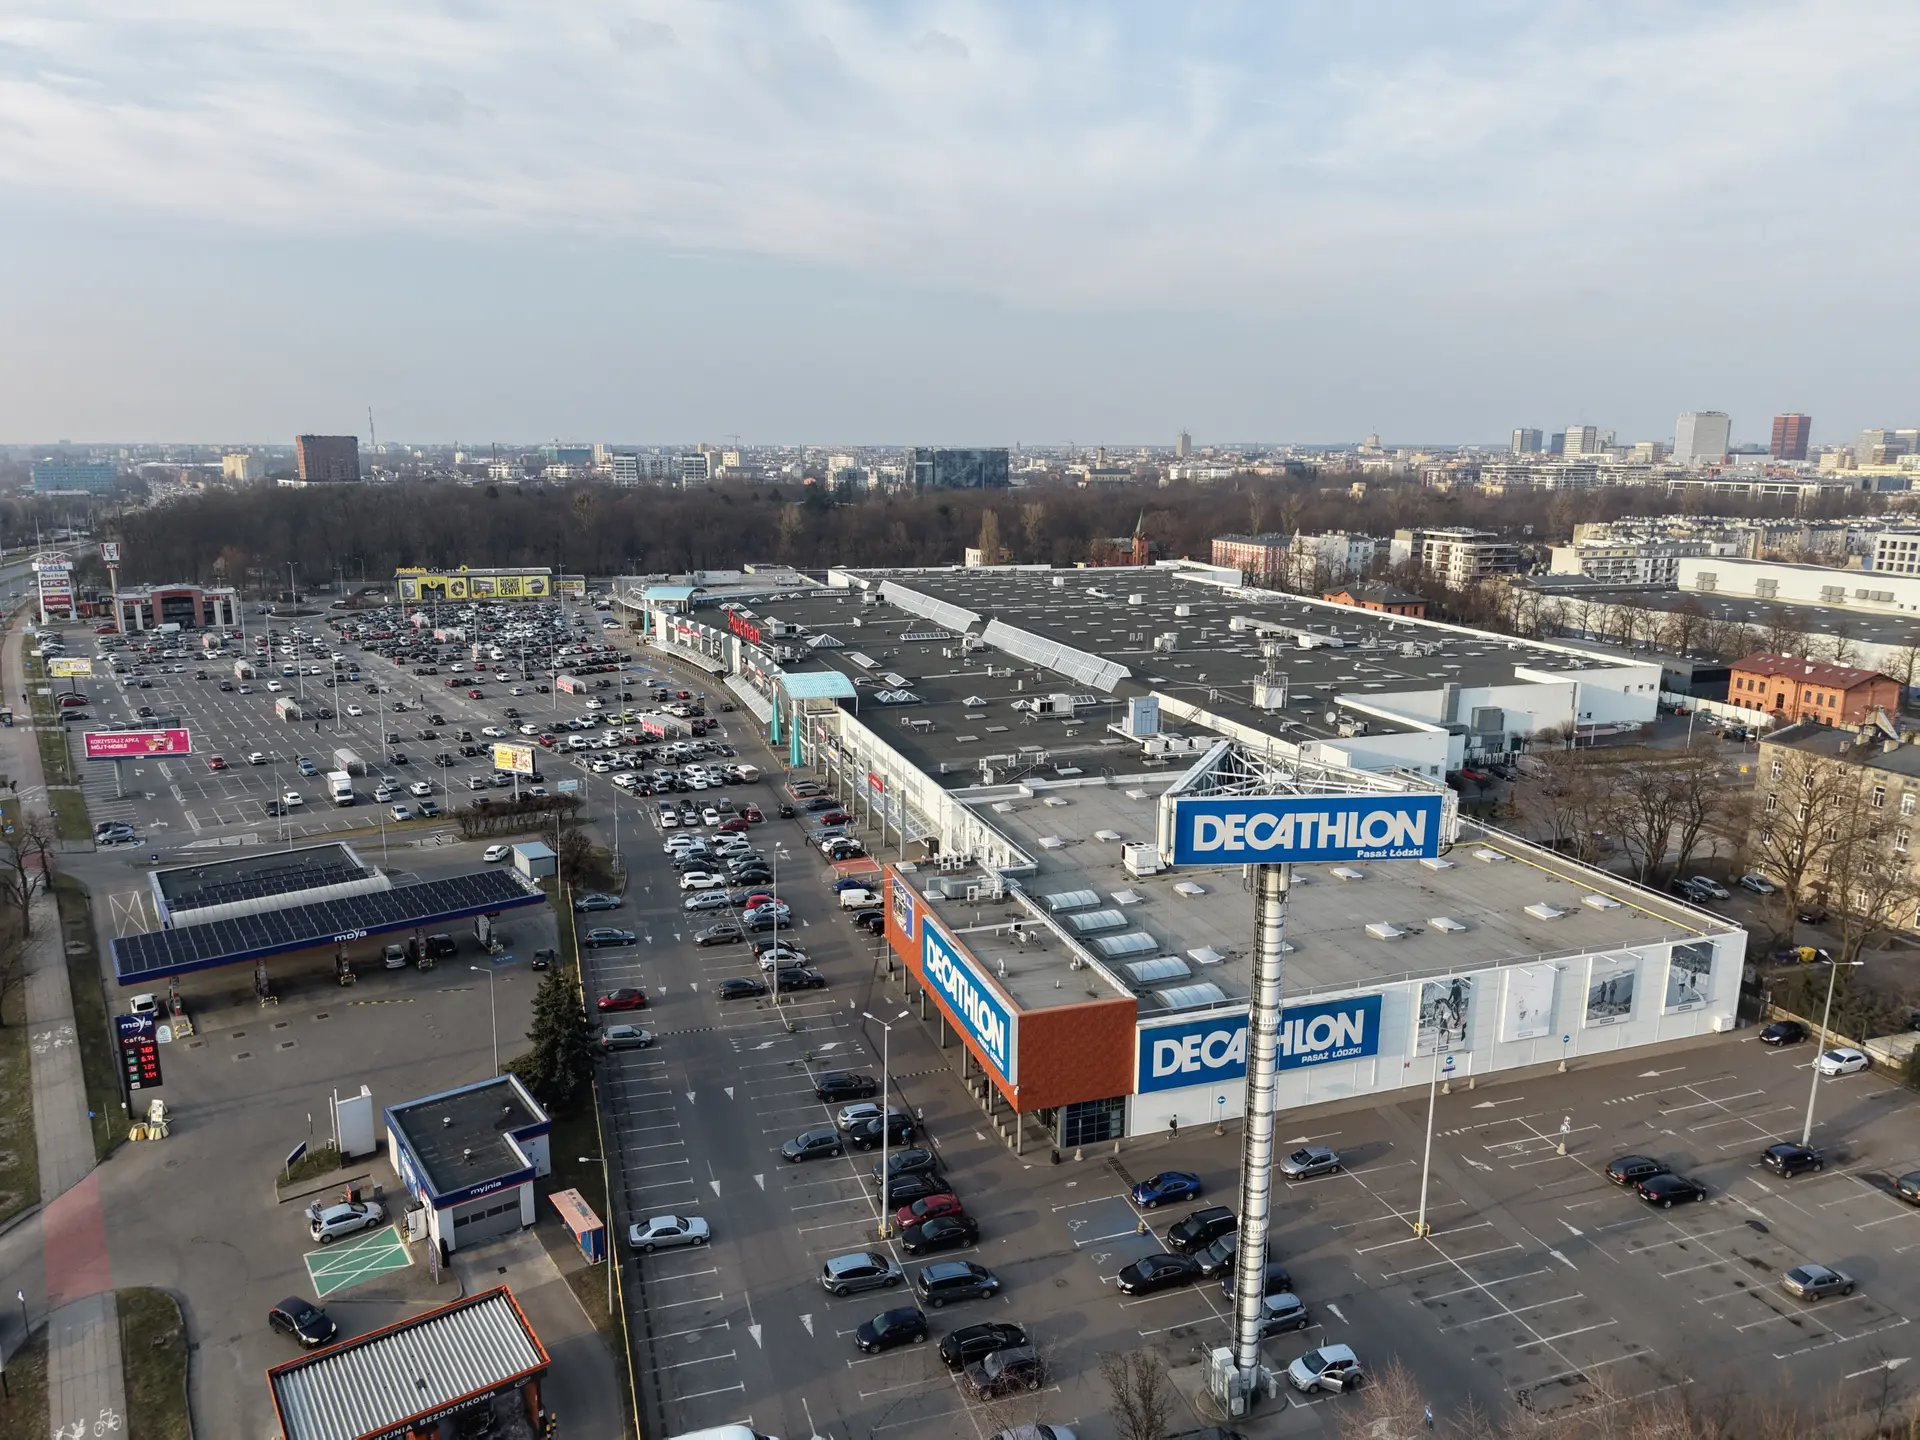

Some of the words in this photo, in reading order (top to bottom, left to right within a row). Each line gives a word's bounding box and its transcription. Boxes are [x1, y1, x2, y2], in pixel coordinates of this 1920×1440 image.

[728, 607, 760, 645] Auchan
[1193, 809, 1427, 852] DECATHLON
[1357, 849, 1387, 858] Pasaż
[1389, 848, 1423, 858] Łódzki
[334, 928, 368, 942] moya
[926, 934, 1005, 1060] DECATHLON
[121, 1016, 152, 1032] moya
[1152, 1009, 1366, 1078] DECAHLON
[1301, 1052, 1329, 1063] PASAŻ
[1332, 1047, 1362, 1058] ŁÓDZKI
[470, 1180, 502, 1195] myjnia
[419, 1391, 496, 1426] BEZDOTYKOWA
